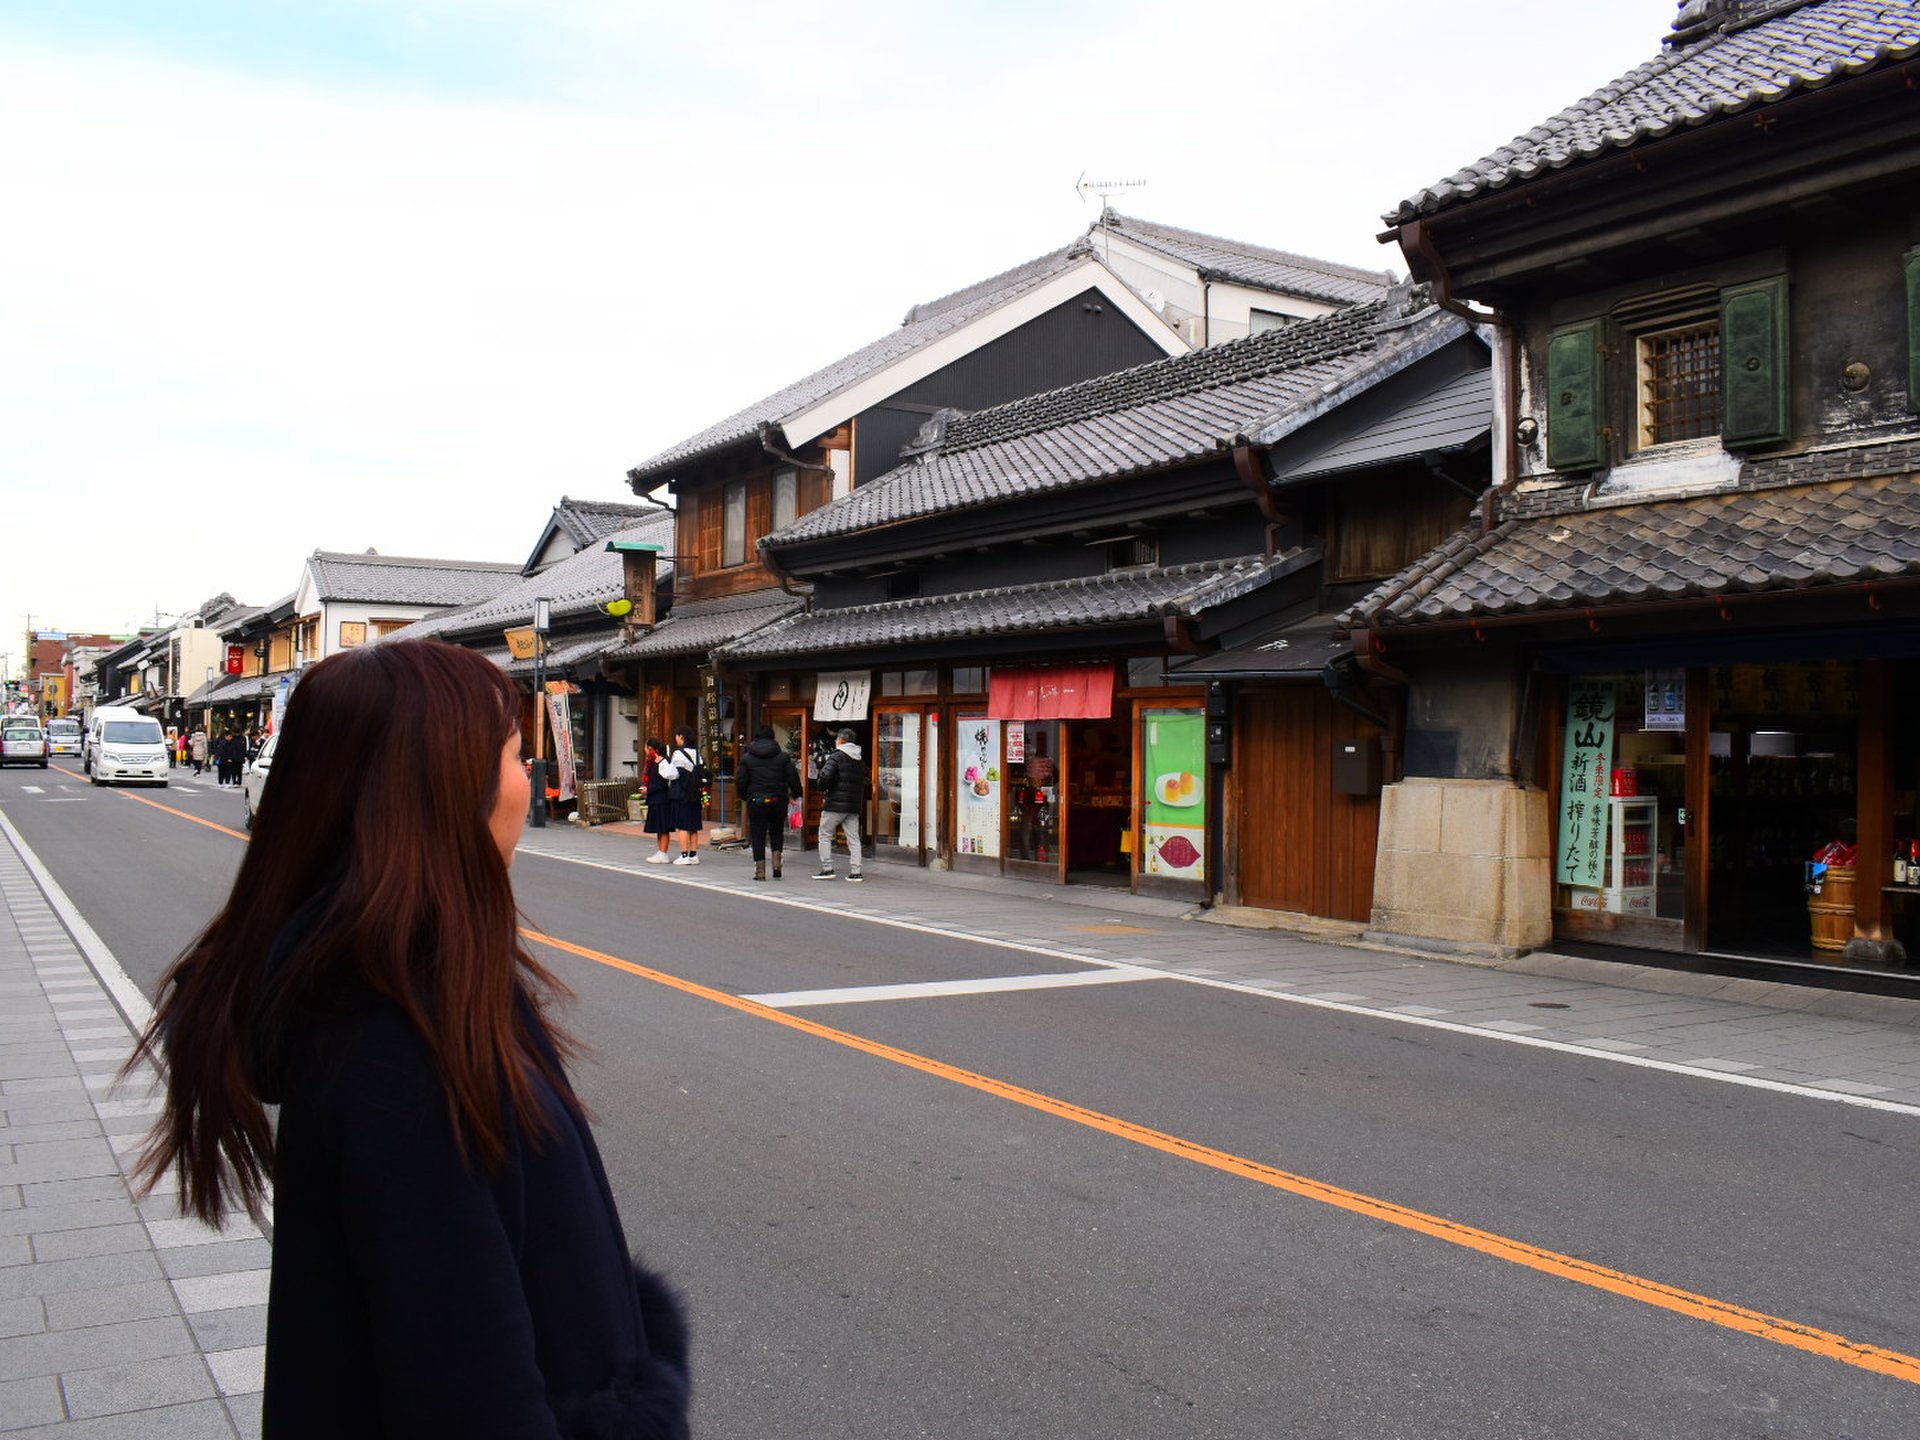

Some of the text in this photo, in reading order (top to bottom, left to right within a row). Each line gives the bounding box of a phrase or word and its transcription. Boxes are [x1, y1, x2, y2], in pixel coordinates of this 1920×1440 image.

[1571, 692, 1614, 749] 鏡山
[1594, 752, 1606, 799] 冬季限定
[1566, 751, 1590, 882] 新酒 搾りたて
